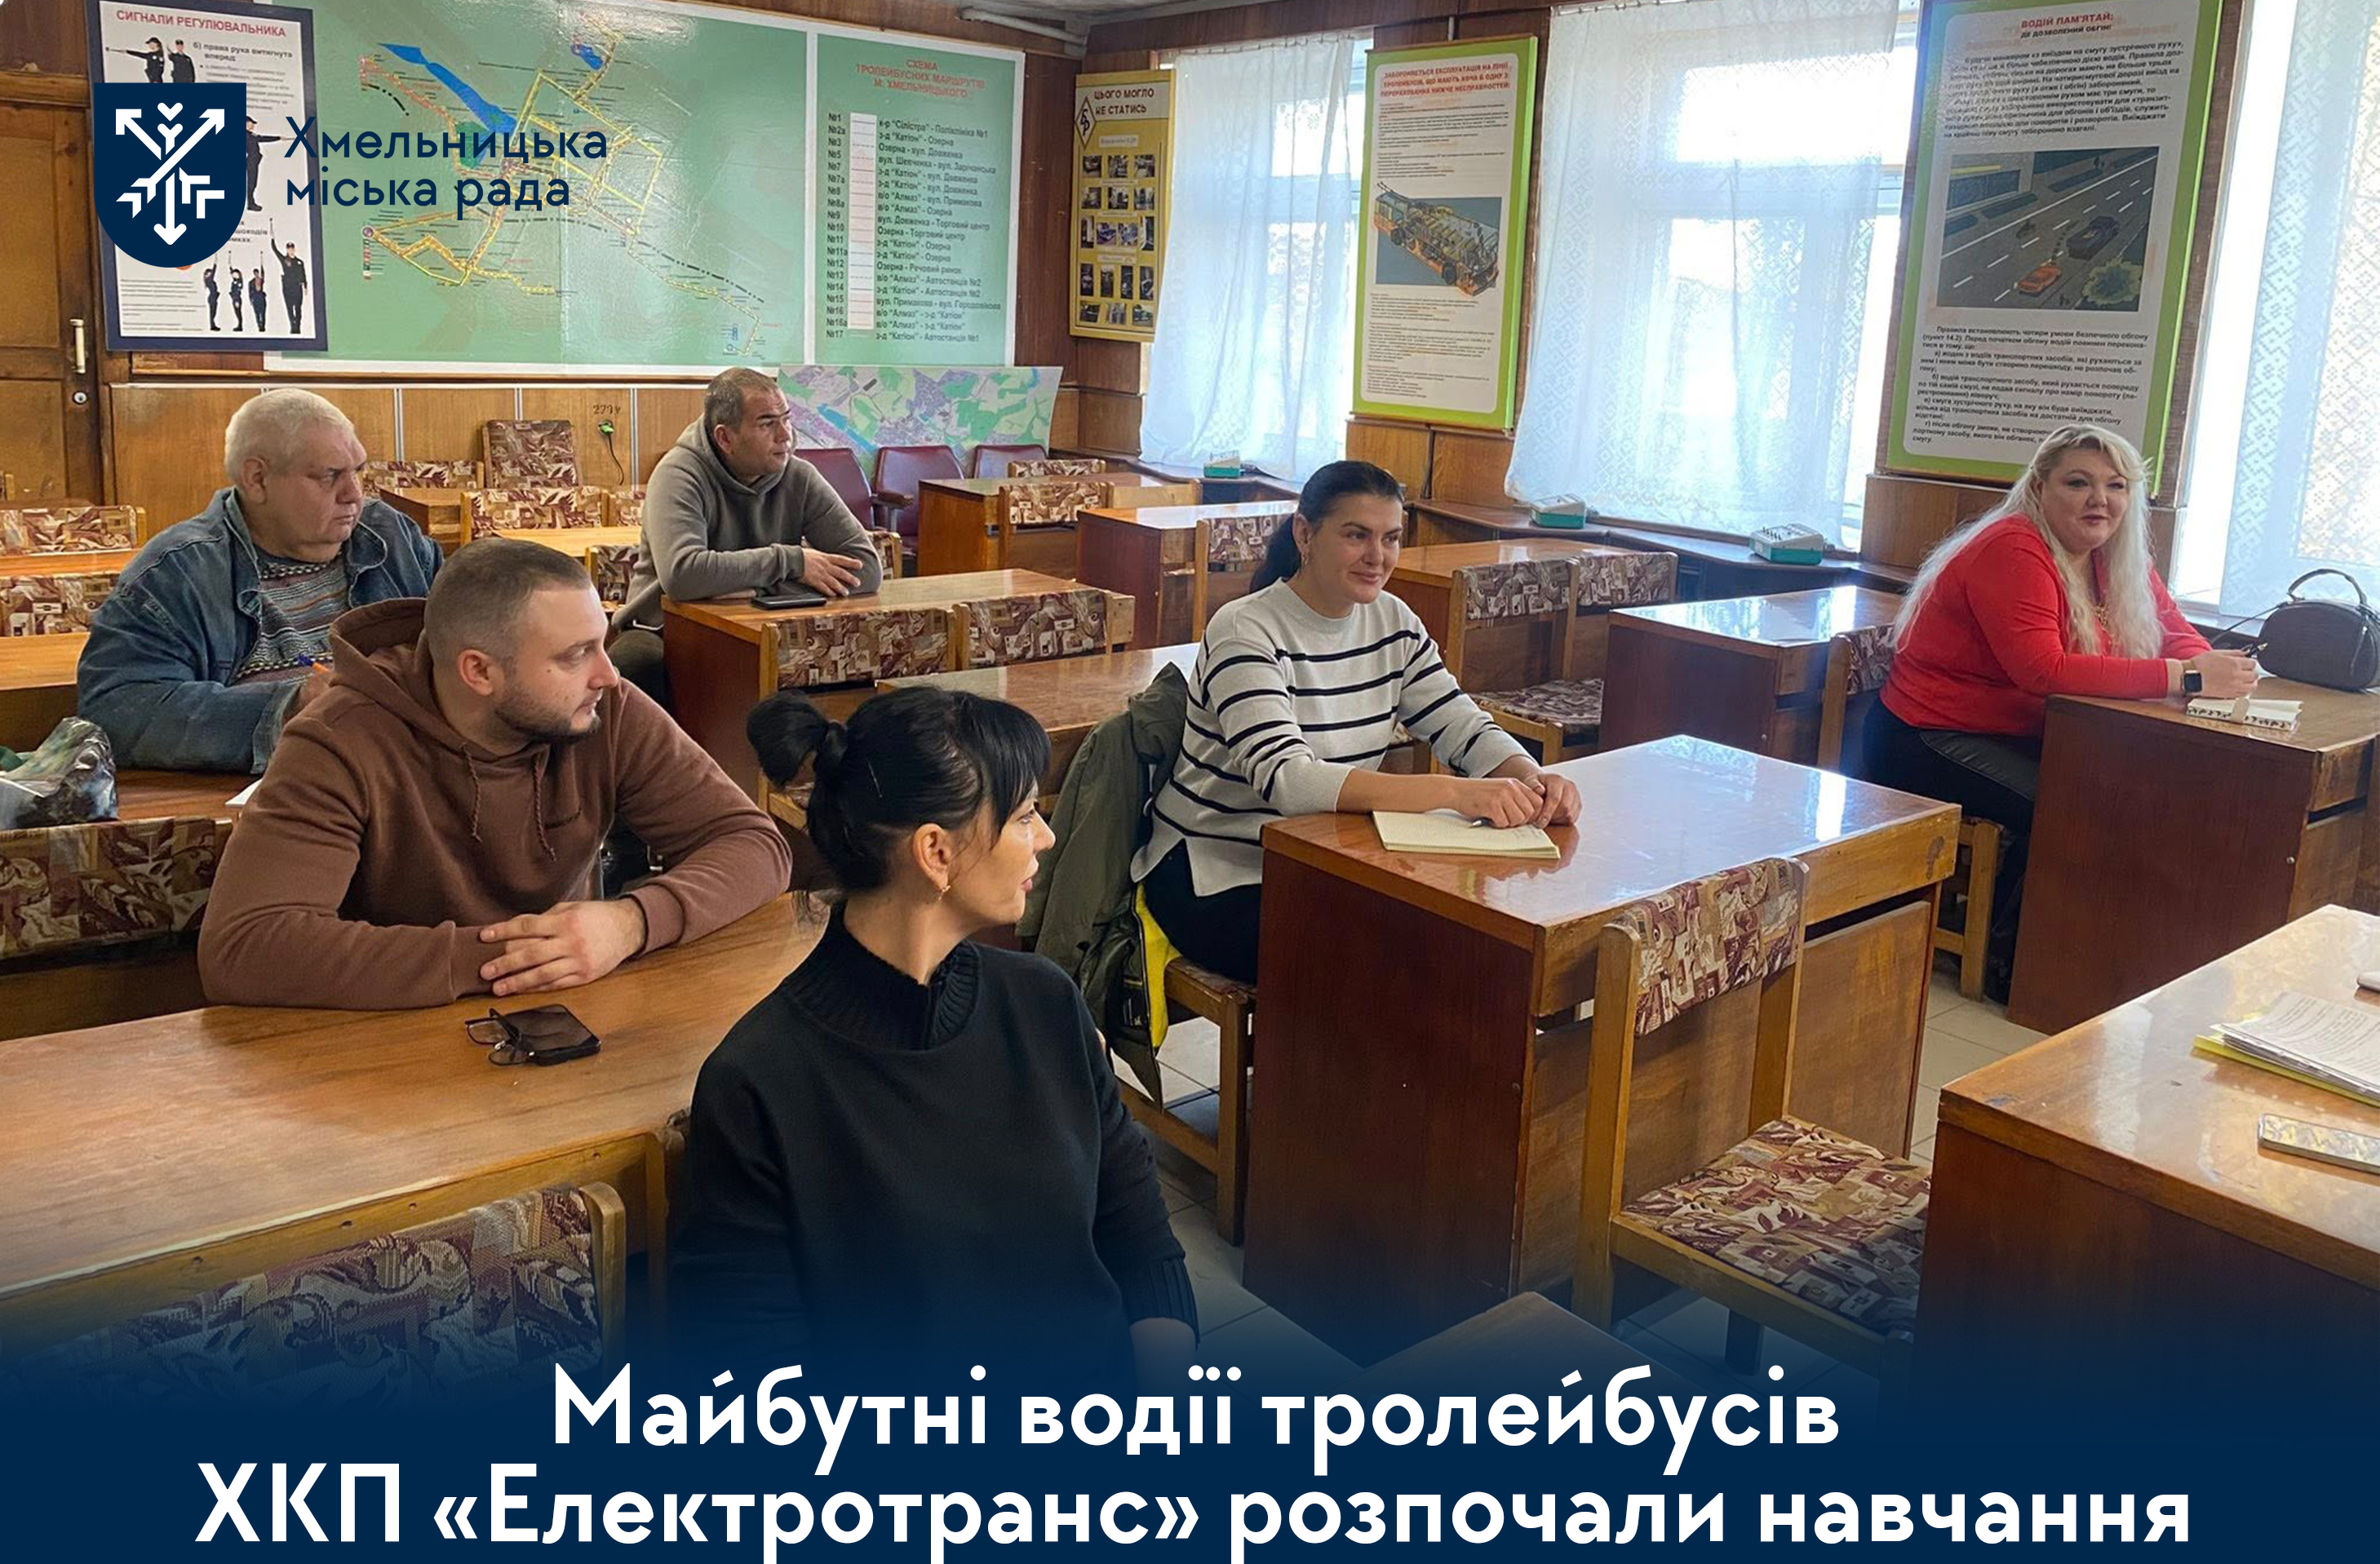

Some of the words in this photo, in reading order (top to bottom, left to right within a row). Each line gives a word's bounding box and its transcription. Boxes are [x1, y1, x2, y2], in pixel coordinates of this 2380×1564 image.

[116, 10, 174, 25] СИГНАЛИ
[177, 15, 286, 37] РЕГУЛЮВАЛЬНИКА
[2021, 18, 2053, 29] ВОДІЙ
[2056, 13, 2114, 25] ПАМ'ЯТАЙ:
[906, 59, 938, 71] СХЕМА
[1094, 90, 1122, 100] ЦЬОГО
[1124, 88, 1154, 98] МОГЛО
[1096, 106, 1106, 115] НЕ
[1108, 104, 1147, 115] СТАТИСЬ
